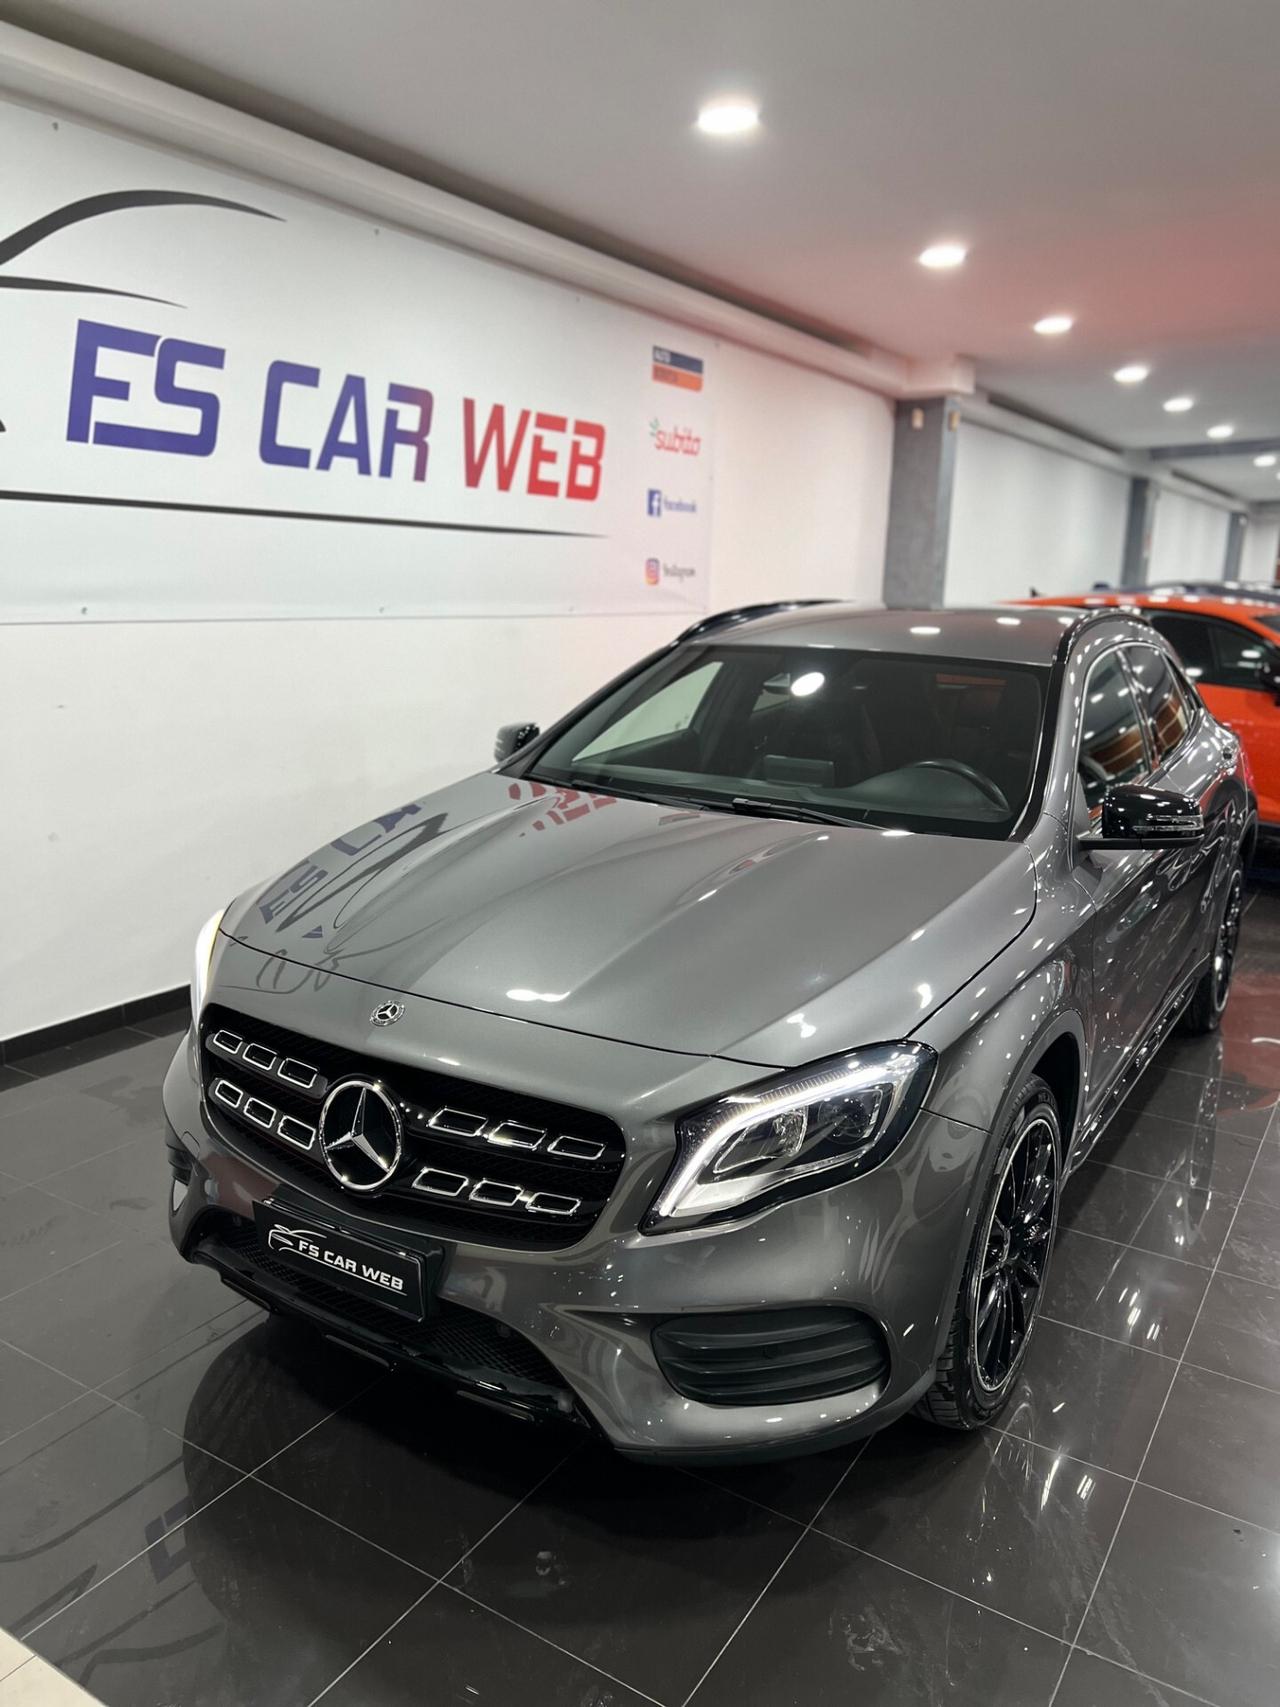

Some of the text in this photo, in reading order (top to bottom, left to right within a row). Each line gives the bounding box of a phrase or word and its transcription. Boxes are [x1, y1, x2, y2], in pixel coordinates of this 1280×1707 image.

[259, 360, 433, 482] CAR
[462, 397, 606, 502] WEB
[655, 426, 701, 456] subito
[298, 1240, 404, 1290] FS CAR WEB
